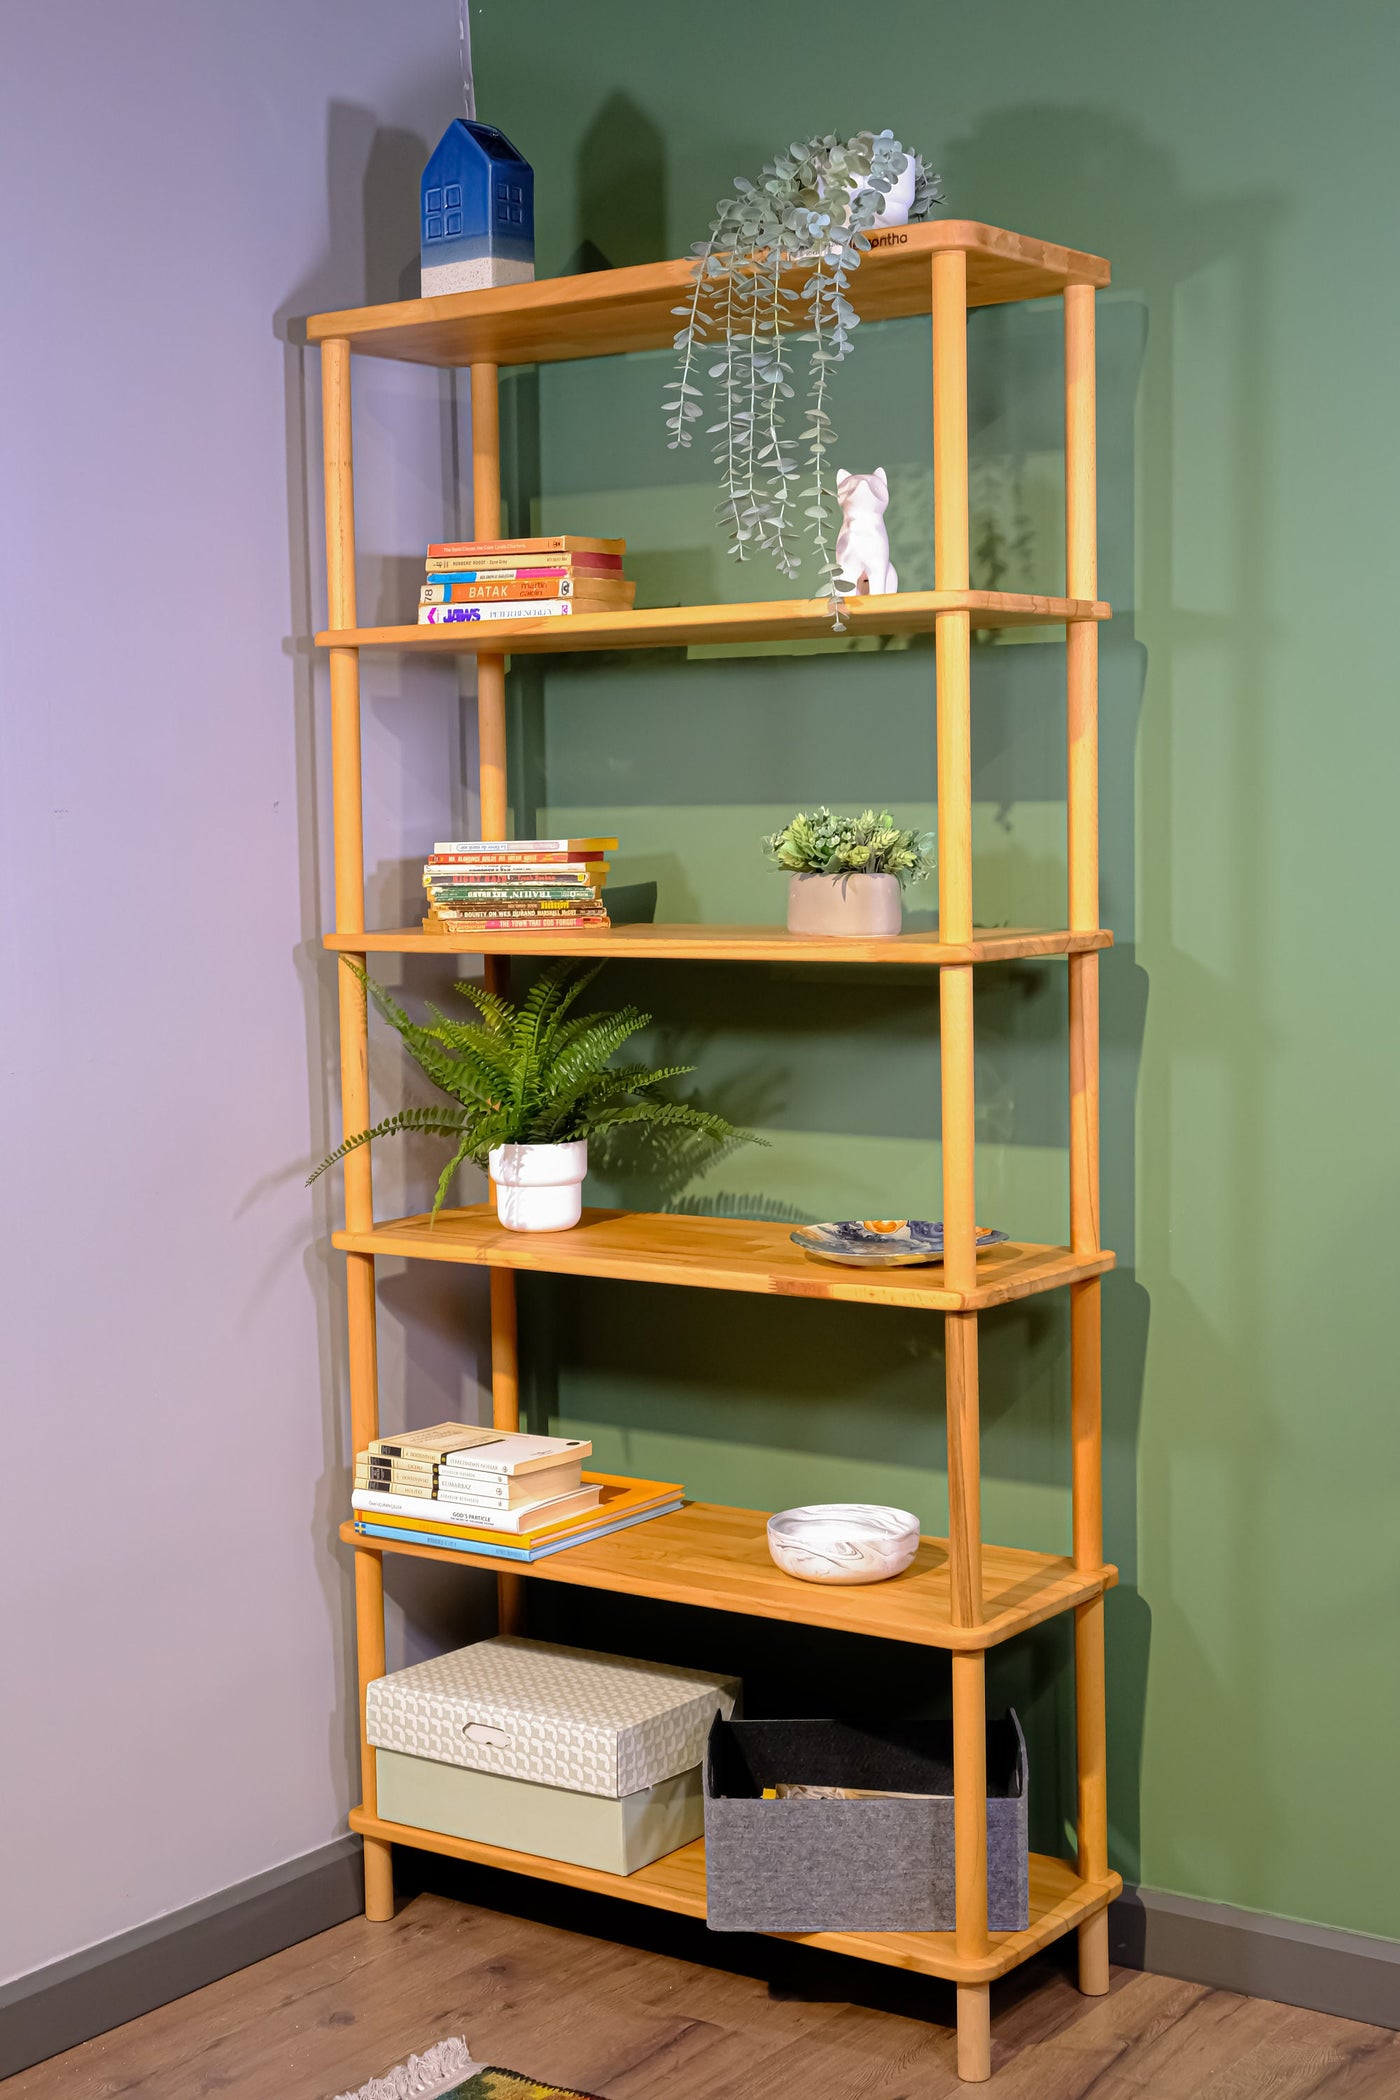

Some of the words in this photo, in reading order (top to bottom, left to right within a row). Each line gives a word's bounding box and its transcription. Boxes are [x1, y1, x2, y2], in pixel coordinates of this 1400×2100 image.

[424, 588, 434, 603] 78
[468, 585, 509, 599] BATAK
[443, 608, 481, 623] JAWS
[512, 909, 536, 917] DURAND
[452, 1511, 468, 1519] GOD'S
[468, 1513, 491, 1522] PARTICLE
